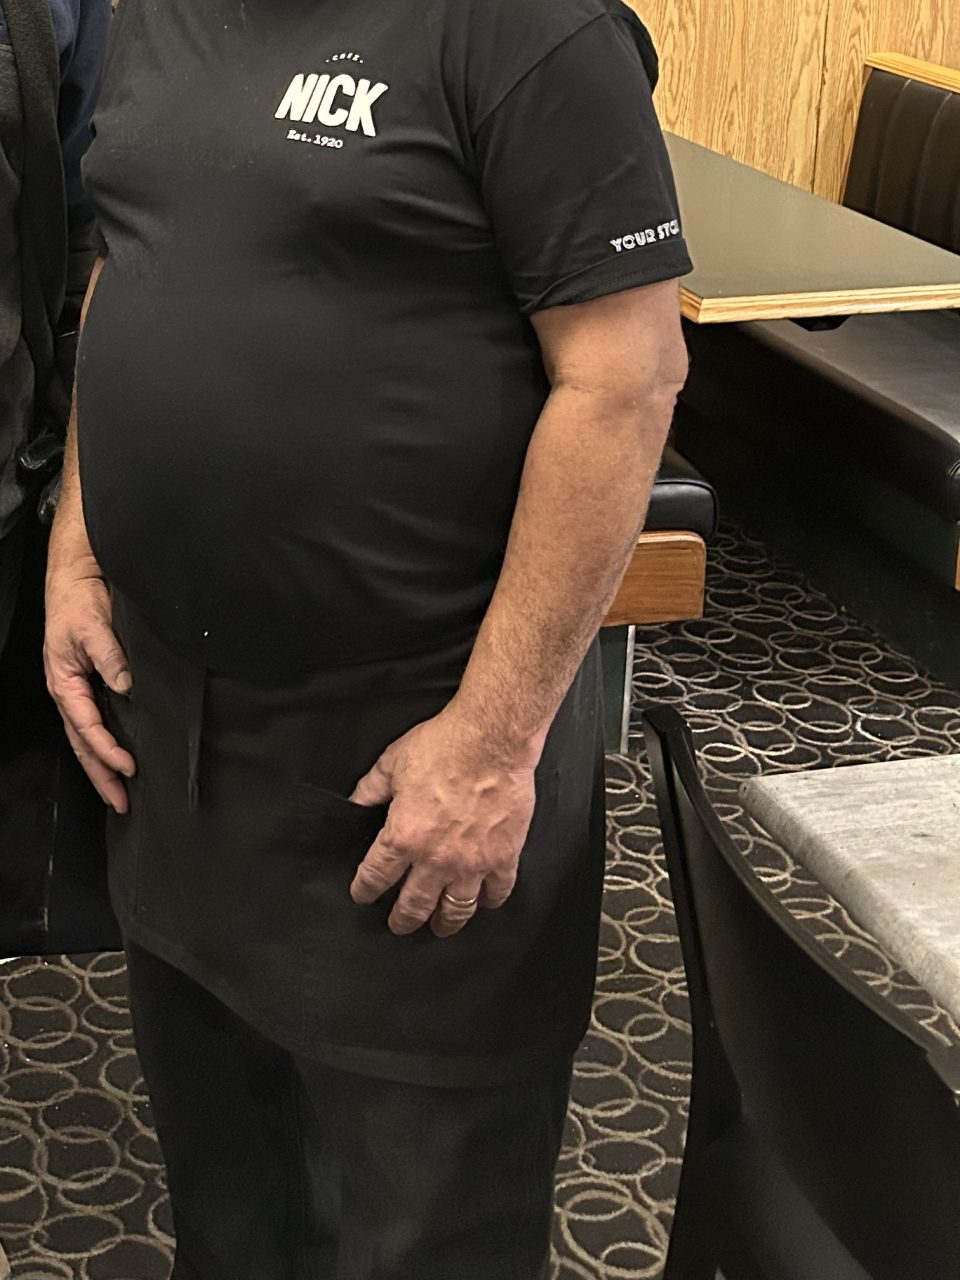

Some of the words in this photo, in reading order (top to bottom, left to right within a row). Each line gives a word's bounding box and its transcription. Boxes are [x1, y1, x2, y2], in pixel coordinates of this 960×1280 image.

[274, 73, 389, 137] NICK
[286, 129, 311, 142] Est.
[313, 134, 344, 149] 1920
[610, 228, 657, 252] YOUR
